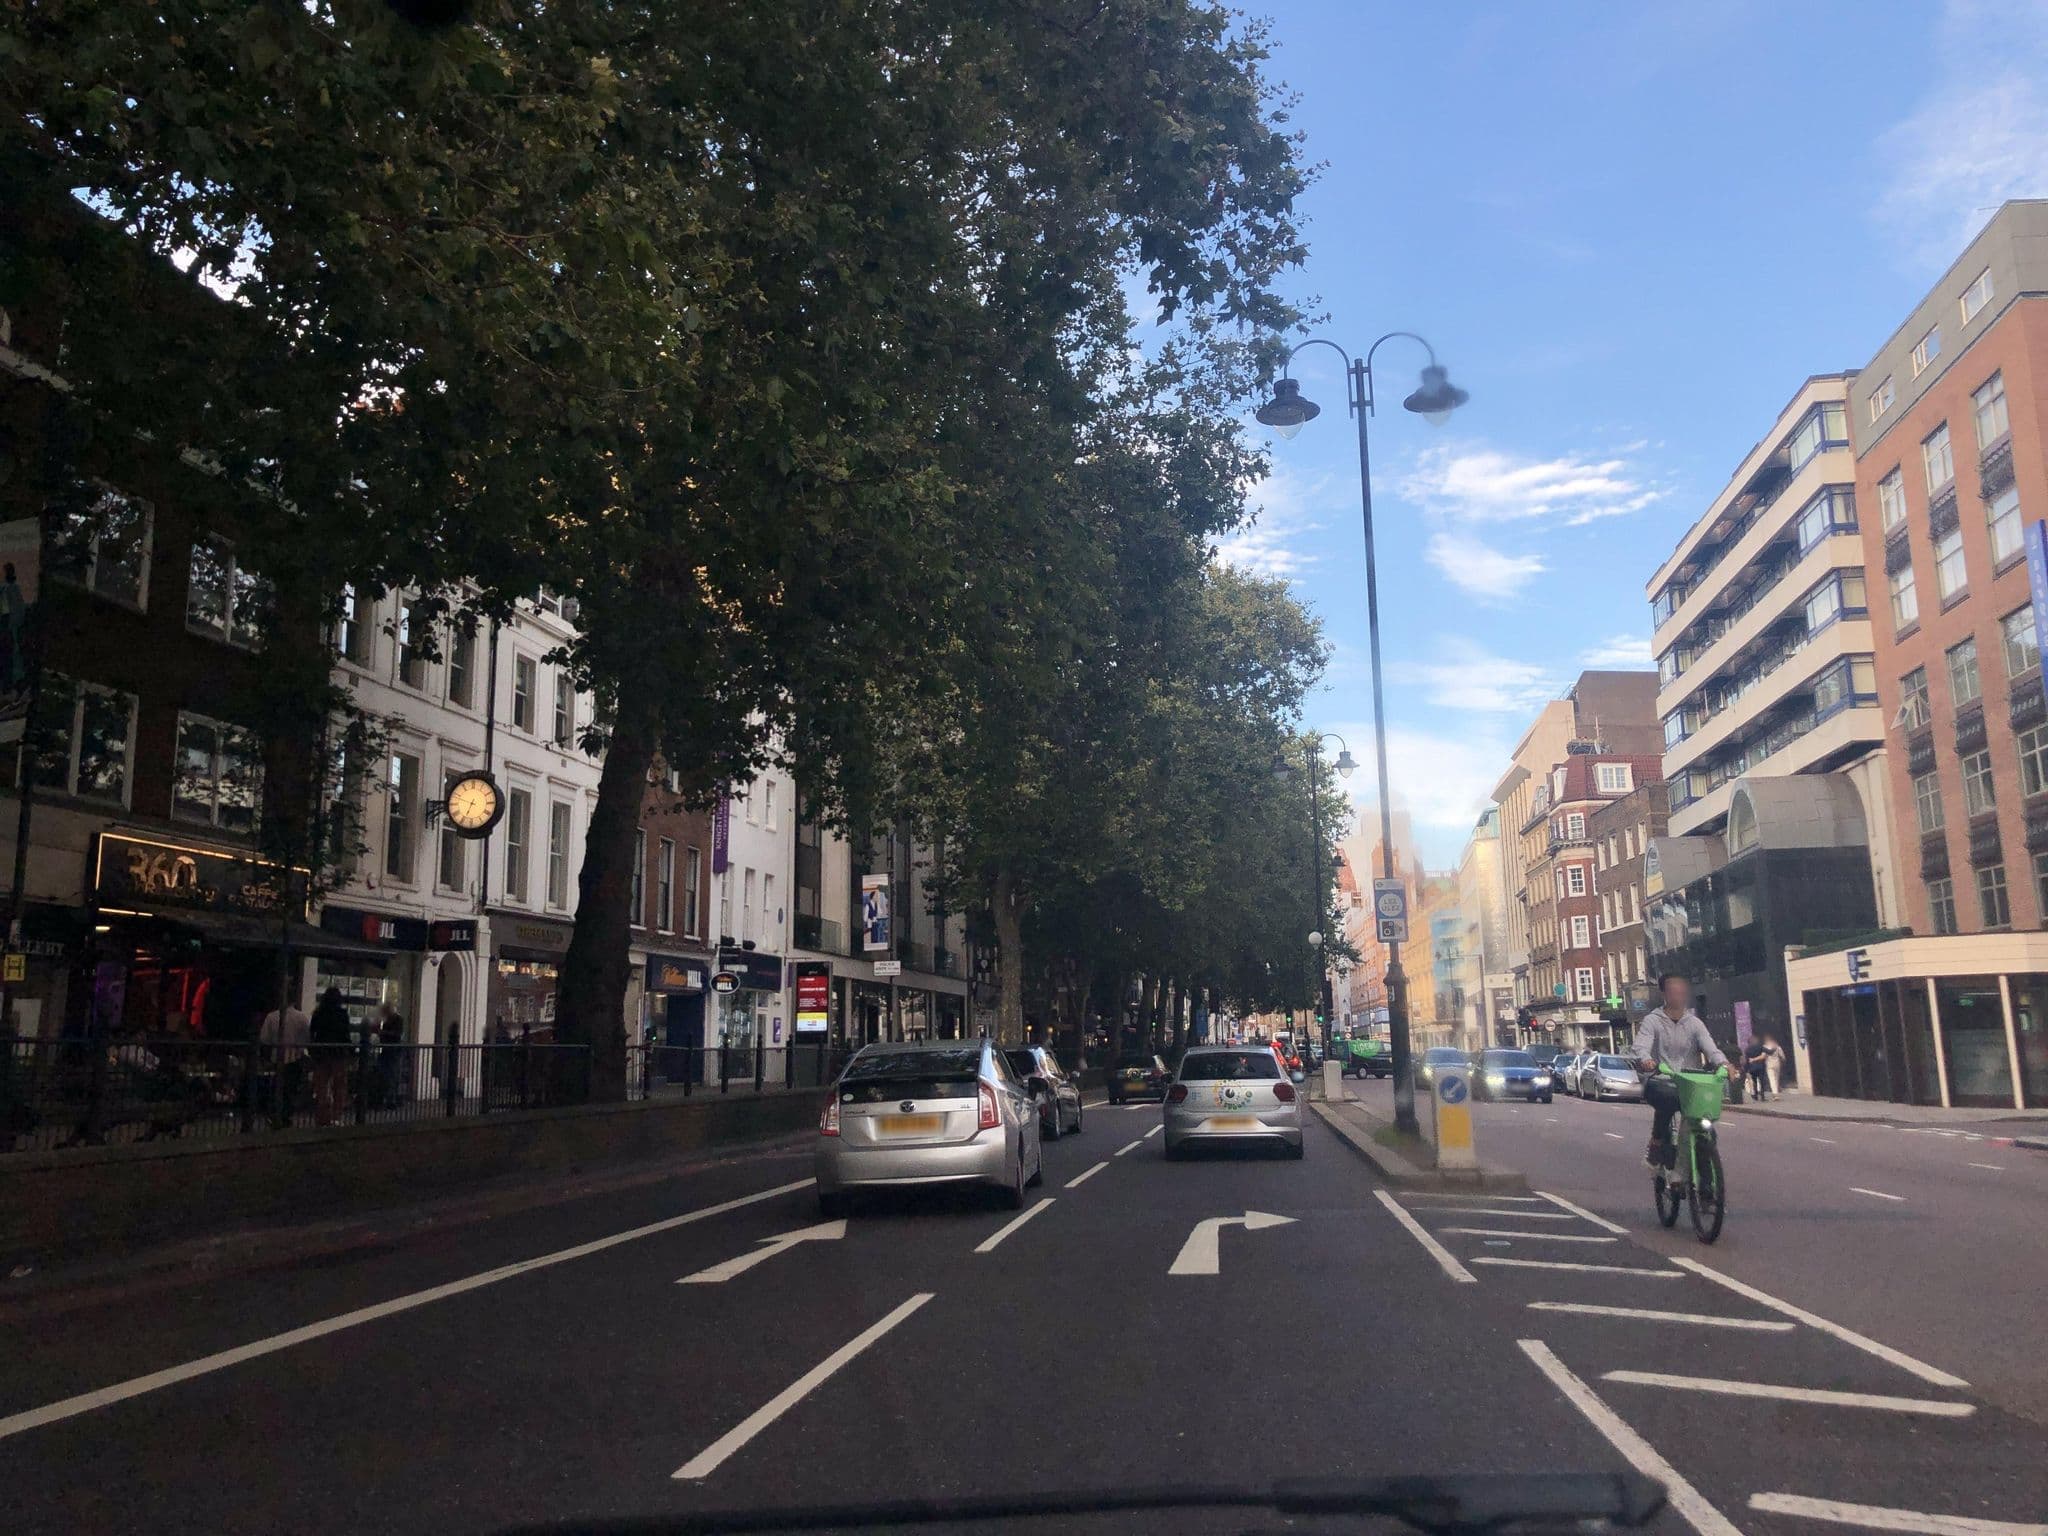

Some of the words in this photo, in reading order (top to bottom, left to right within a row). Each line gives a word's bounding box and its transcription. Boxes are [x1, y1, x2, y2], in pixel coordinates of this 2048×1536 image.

[449, 928, 471, 942] JLL
[687, 969, 702, 988] HILL
[716, 981, 733, 991] HILL
